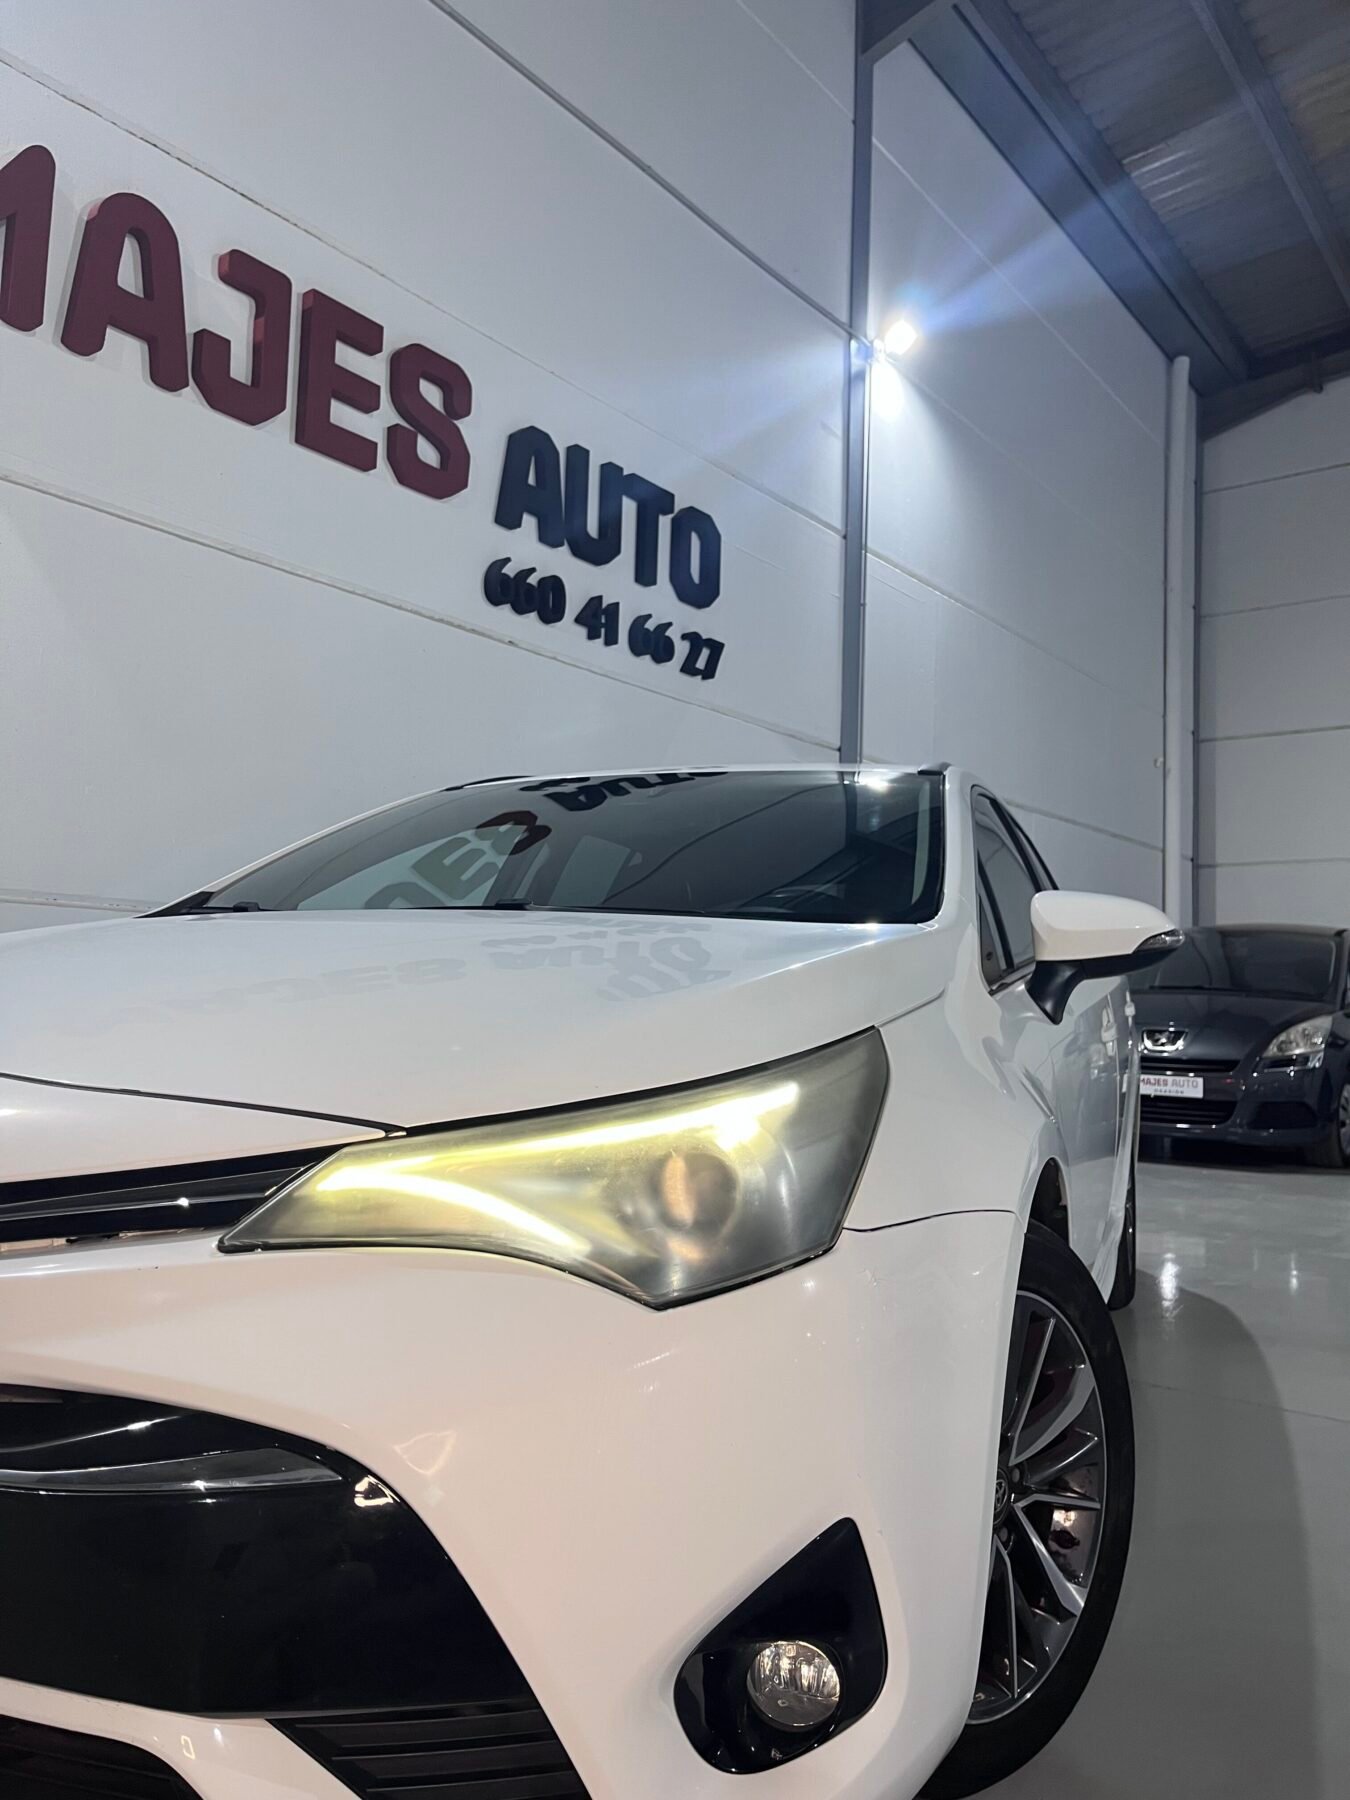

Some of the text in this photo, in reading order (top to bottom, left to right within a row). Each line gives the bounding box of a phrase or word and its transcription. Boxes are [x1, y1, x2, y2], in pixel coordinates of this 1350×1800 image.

[494, 425, 722, 610] AUTO
[484, 556, 725, 680] 660 41 66 27
[1171, 1078, 1199, 1089] AUTO
